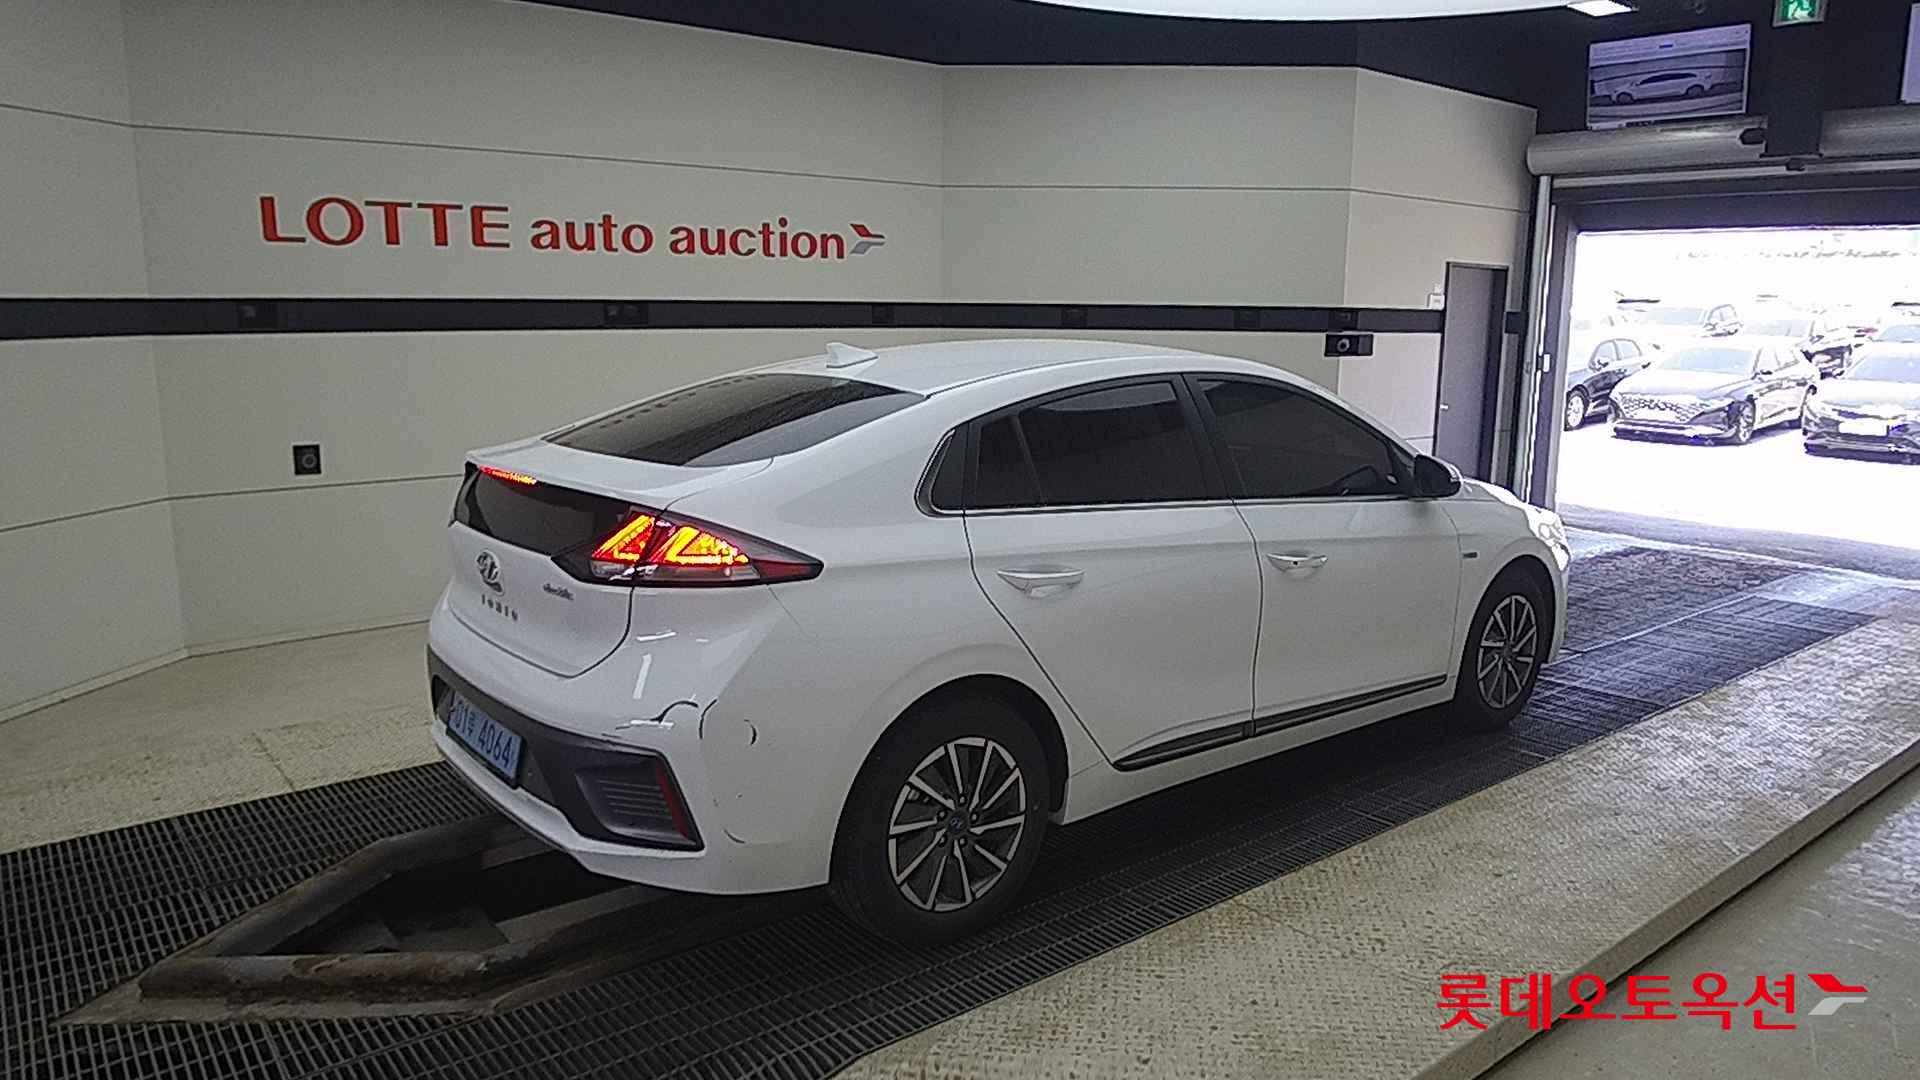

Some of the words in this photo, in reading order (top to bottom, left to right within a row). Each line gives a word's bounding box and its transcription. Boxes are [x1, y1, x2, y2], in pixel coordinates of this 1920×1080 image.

[259, 196, 510, 249] LOTTE
[530, 214, 655, 255] auto
[669, 218, 846, 260] auction
[479, 719, 513, 769] 4064
